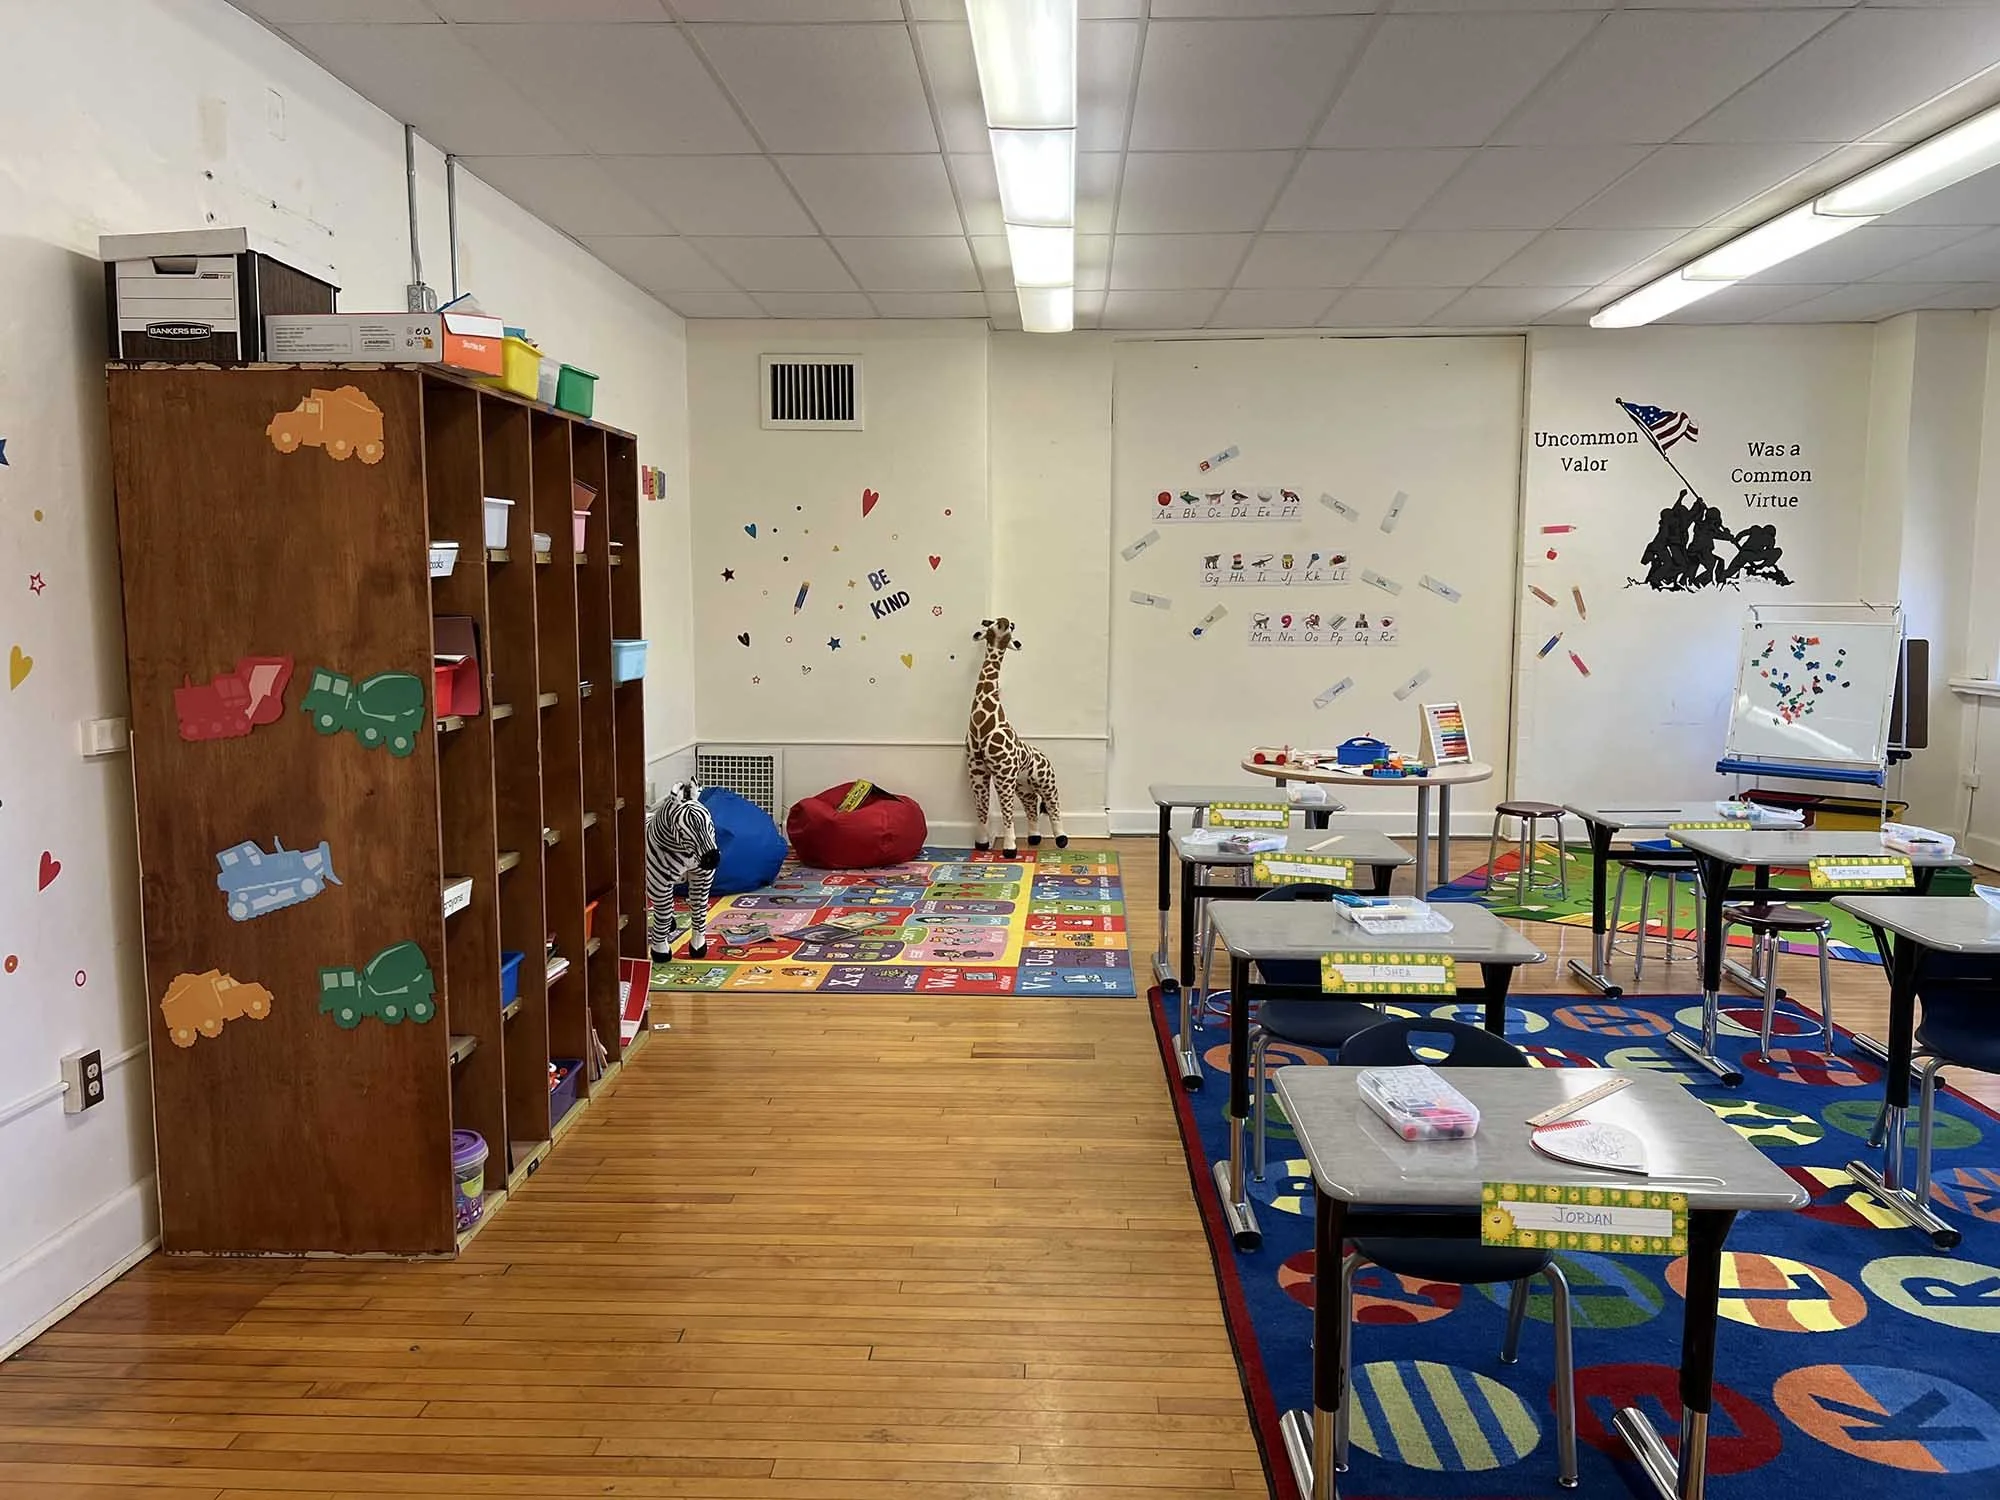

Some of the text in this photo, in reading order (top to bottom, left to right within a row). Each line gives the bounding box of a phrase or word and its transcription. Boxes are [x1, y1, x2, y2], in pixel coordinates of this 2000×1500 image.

[1534, 431, 1639, 447] Uncommon
[1747, 443, 1801, 457] Was a
[1561, 457, 1609, 472] Valor
[1731, 469, 1812, 483] Common
[1744, 493, 1799, 507] Virtue
[1157, 506, 1298, 519] Aa Bb Cc Dd Ee Ff
[867, 569, 891, 591] BE
[1205, 570, 1345, 586] Gg Hh Ii Jj Kk Ll
[870, 591, 911, 619] KIND
[1251, 632, 1394, 646] Mm Nn Oo Pp Qq Rr
[1025, 953, 1054, 966] Uu
[827, 972, 865, 986] Xx
[924, 972, 958, 989] Ww
[1022, 976, 1052, 989] Vv
[1571, 1011, 1651, 1028] V
[1552, 1206, 1613, 1226] JORDAN
[1718, 1273, 1833, 1300] L
[1900, 1276, 2000, 1307] R
[1809, 1387, 1992, 1442] K
